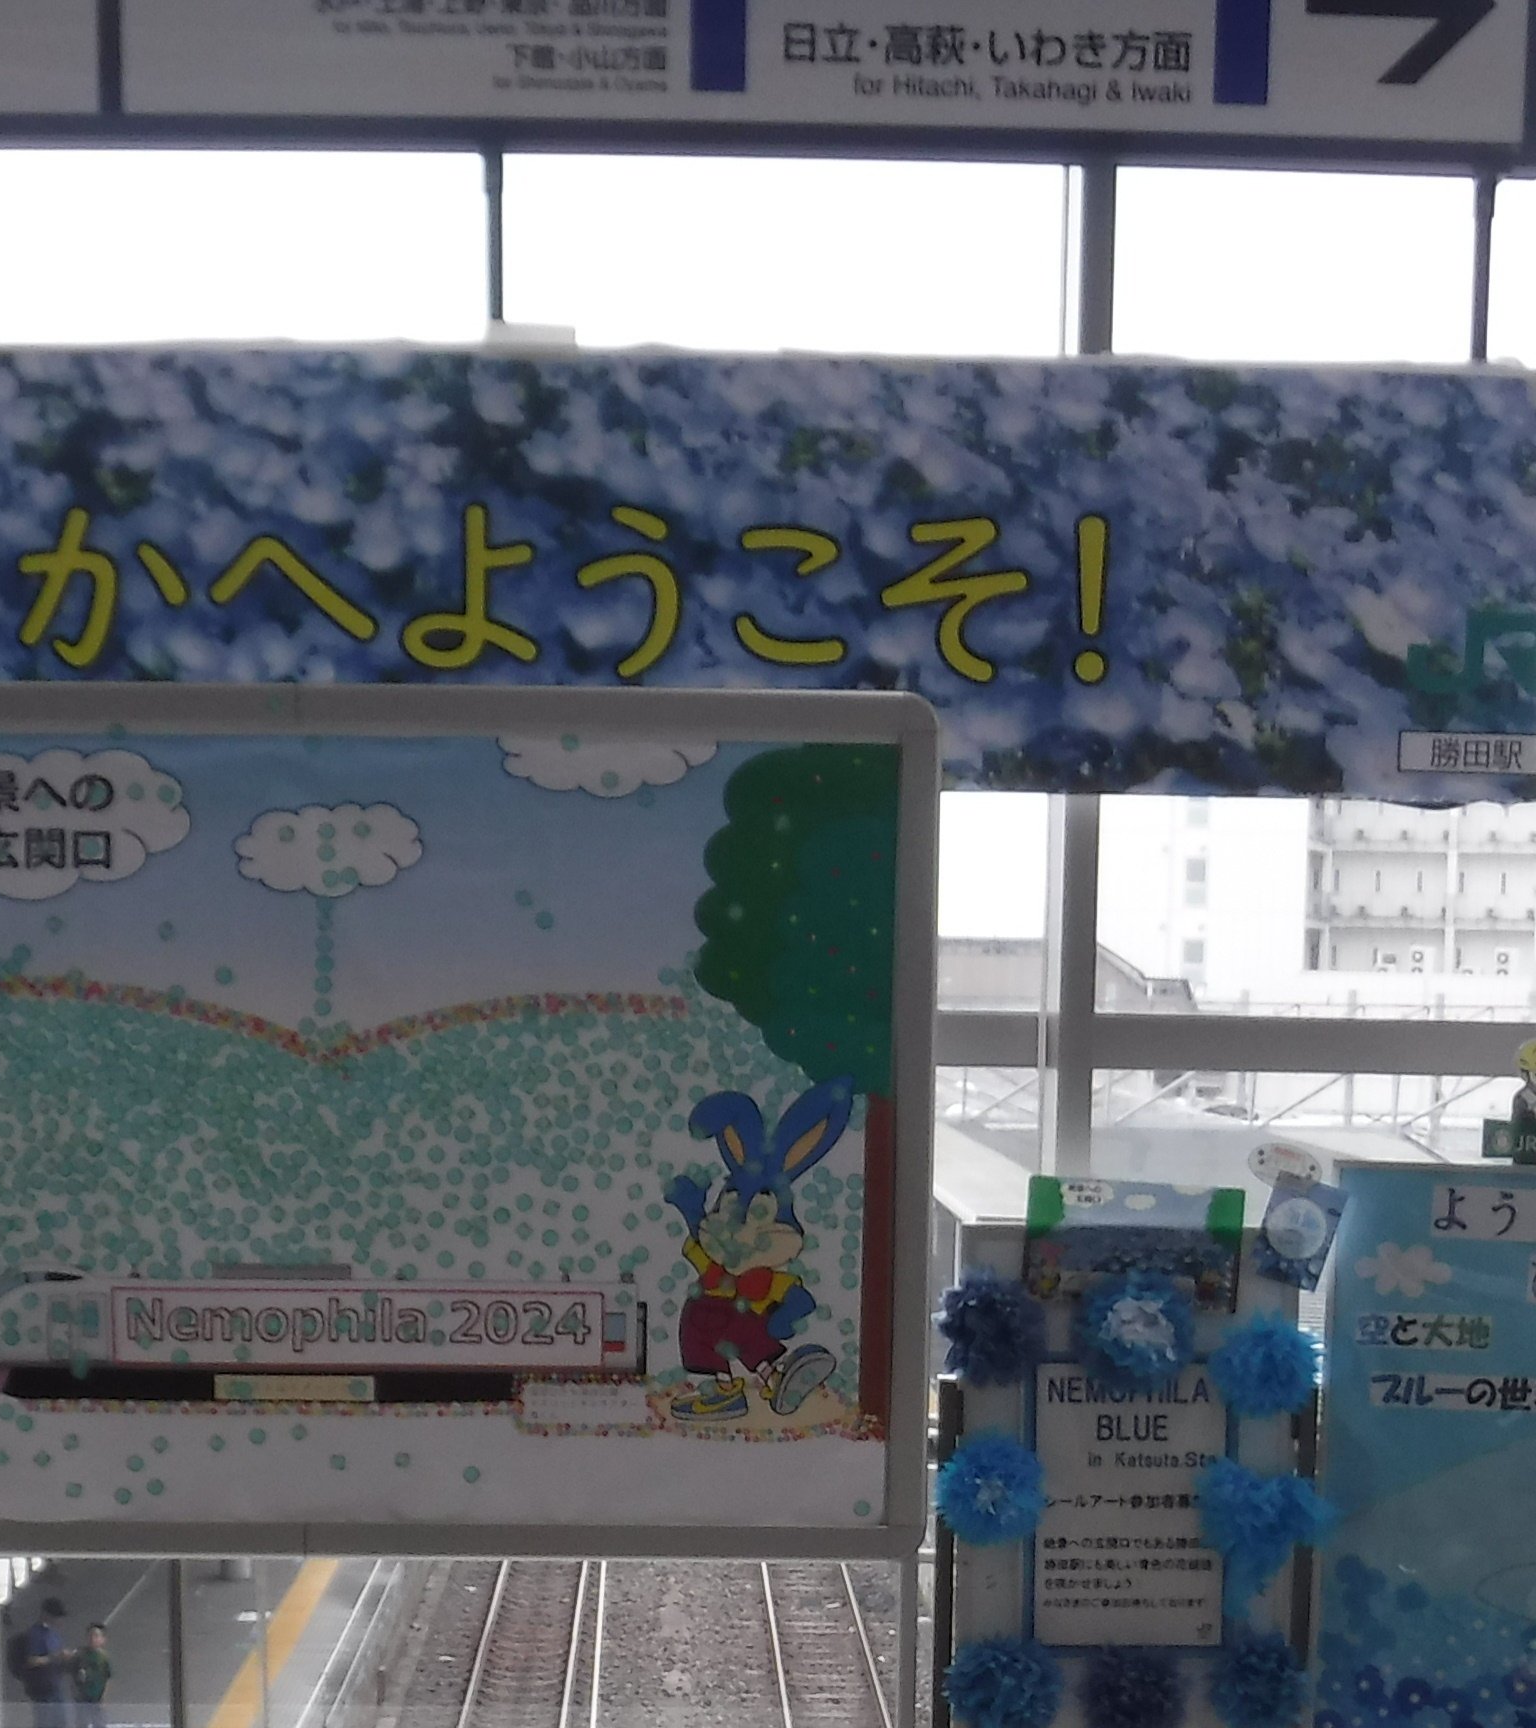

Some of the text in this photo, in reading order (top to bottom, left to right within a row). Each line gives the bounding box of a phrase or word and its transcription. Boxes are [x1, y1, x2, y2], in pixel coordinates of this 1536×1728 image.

[854, 74, 1192, 105] for Hitachi, Takahagi & Iwaki
[1430, 737, 1523, 769] 勝田駅
[124, 1296, 592, 1352] Nemophila 2024
[1356, 1313, 1491, 1350] 空と大地
[1047, 1376, 1210, 1404] NEMILA
[1096, 1414, 1169, 1441] BLUE
[1088, 1451, 1102, 1468] in
